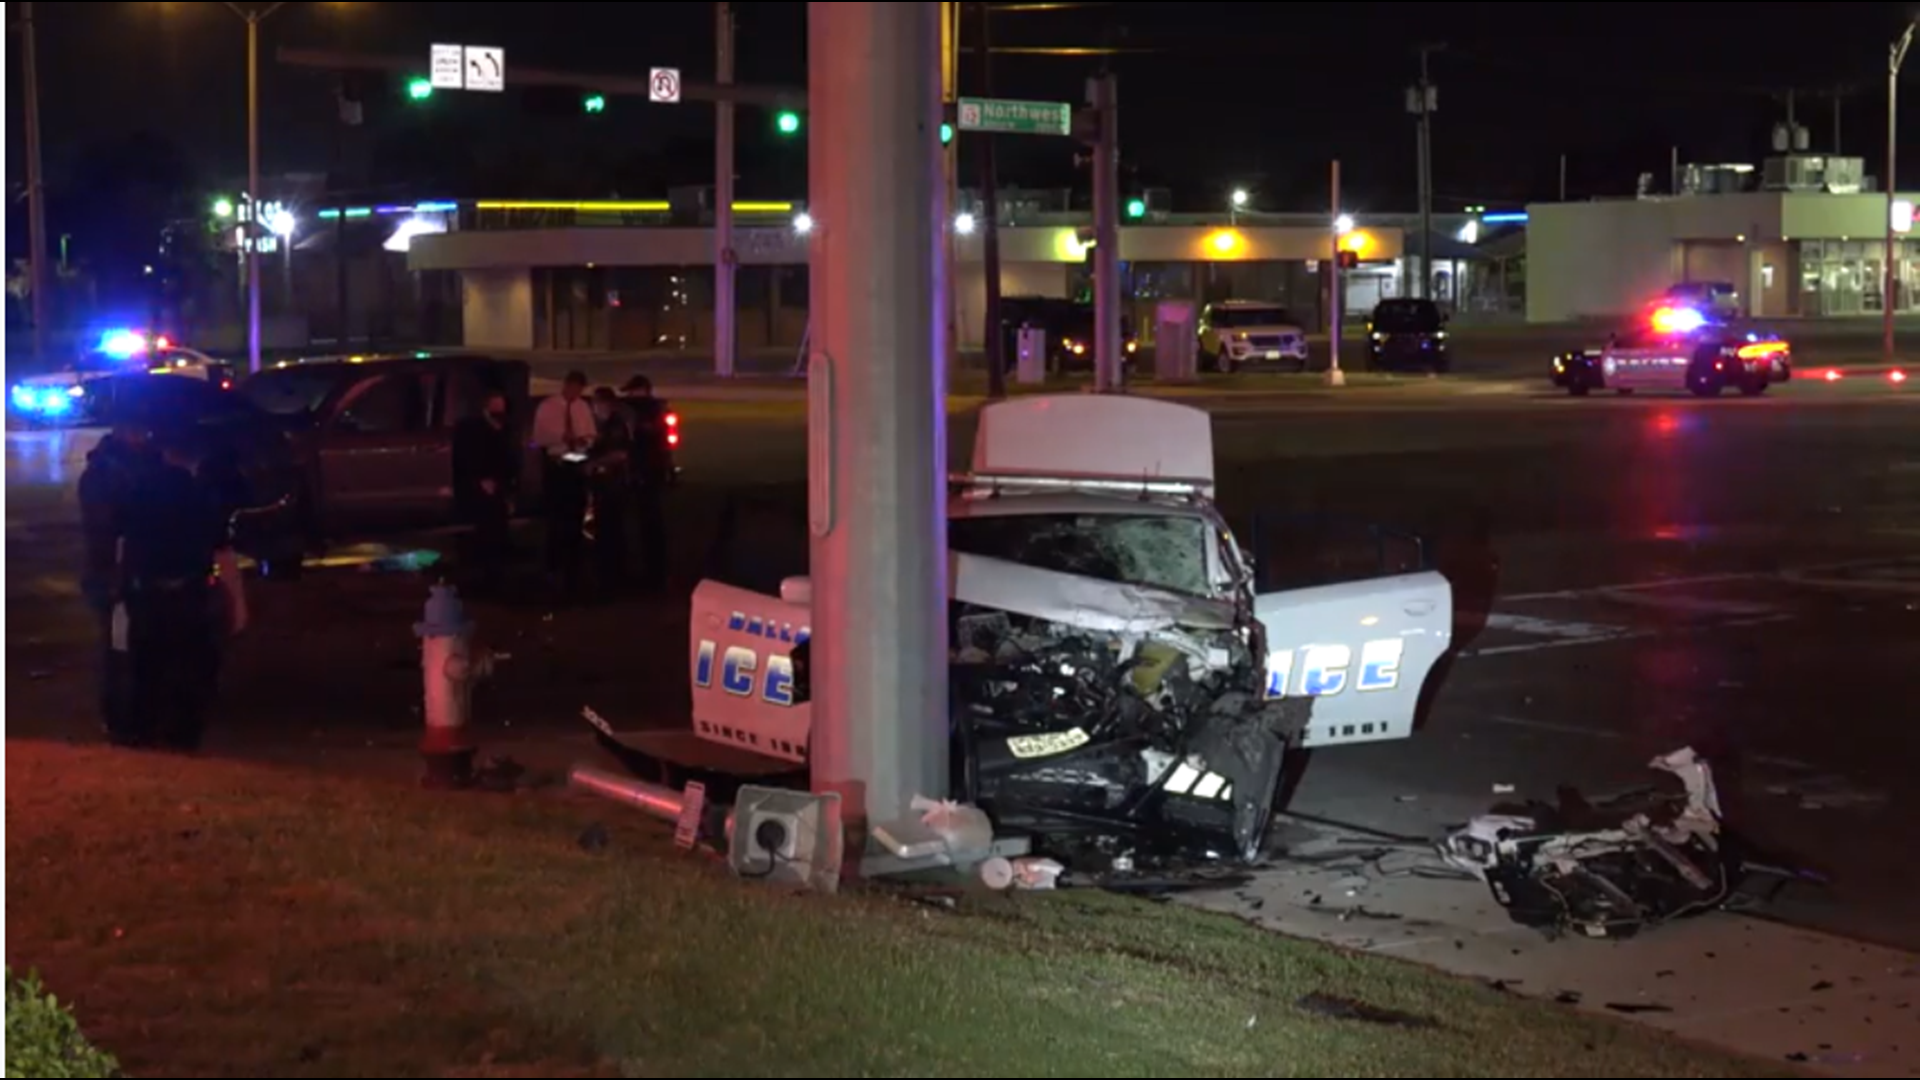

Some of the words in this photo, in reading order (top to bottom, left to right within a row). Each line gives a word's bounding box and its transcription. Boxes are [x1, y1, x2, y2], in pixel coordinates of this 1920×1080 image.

[983, 103, 1065, 123] Northwest
[696, 639, 793, 706] ICE
[1264, 638, 1403, 700] ICE
[700, 721, 757, 746] SINCE
